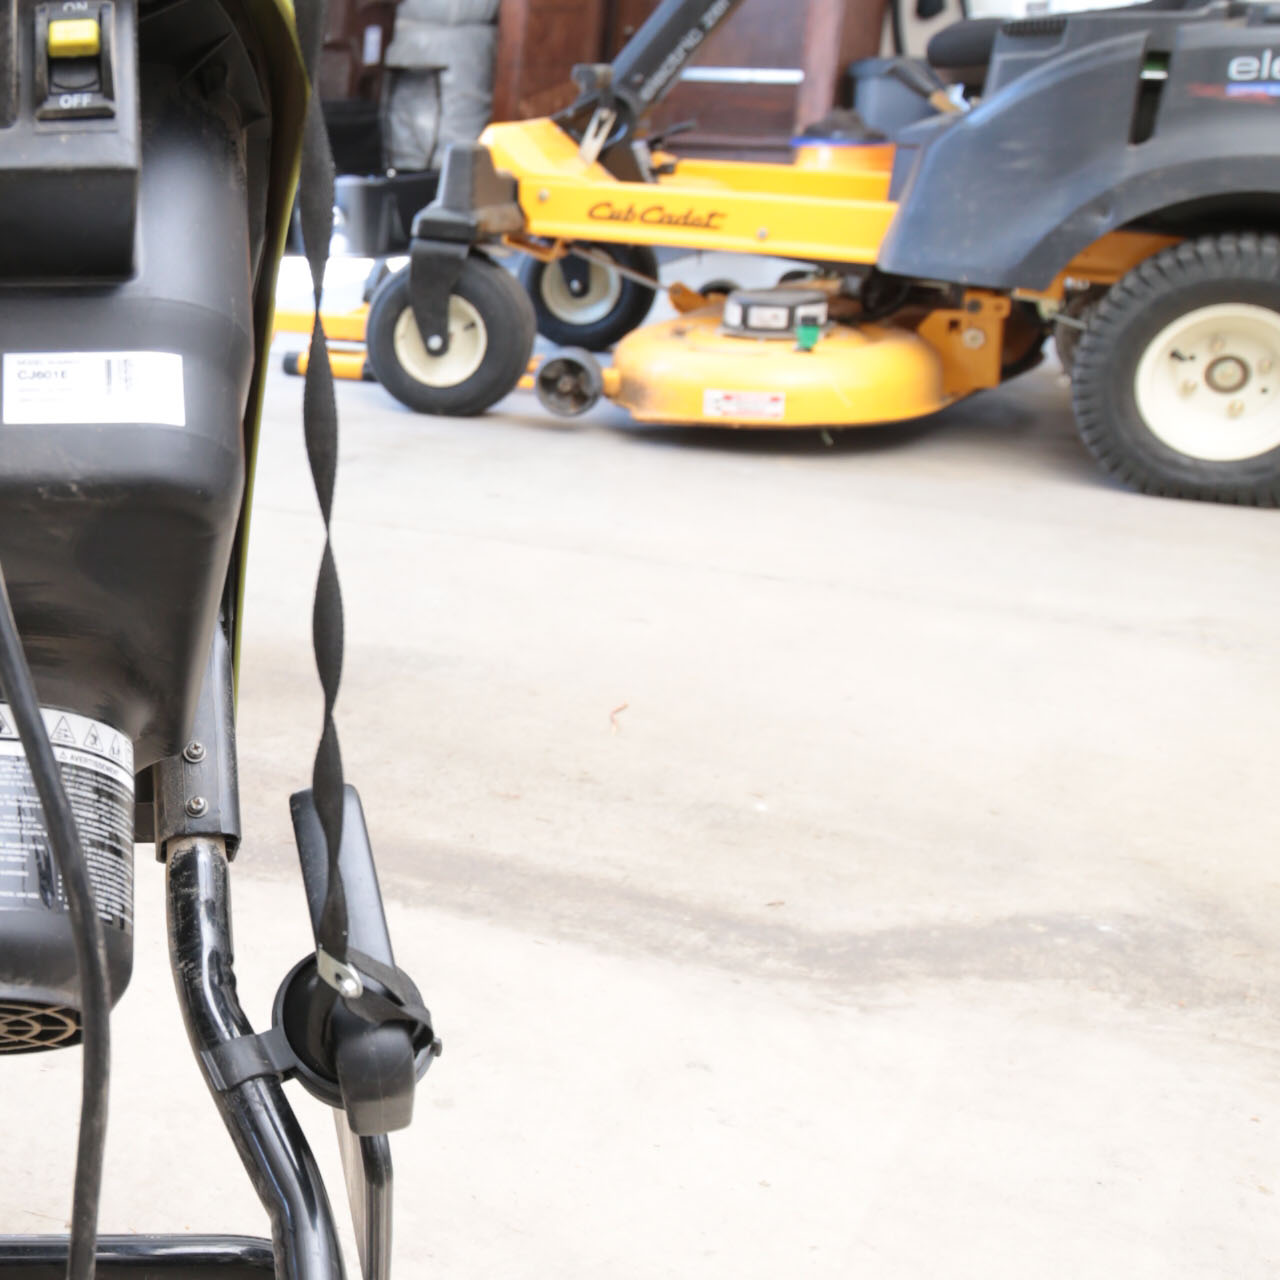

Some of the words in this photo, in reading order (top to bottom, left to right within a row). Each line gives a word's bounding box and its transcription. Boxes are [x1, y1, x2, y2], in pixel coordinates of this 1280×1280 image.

[62, 1, 89, 12] ON
[60, 93, 93, 109] OFF
[587, 201, 635, 223] Cub
[639, 205, 727, 231] Cadet
[16, 369, 68, 381] CJ601E
